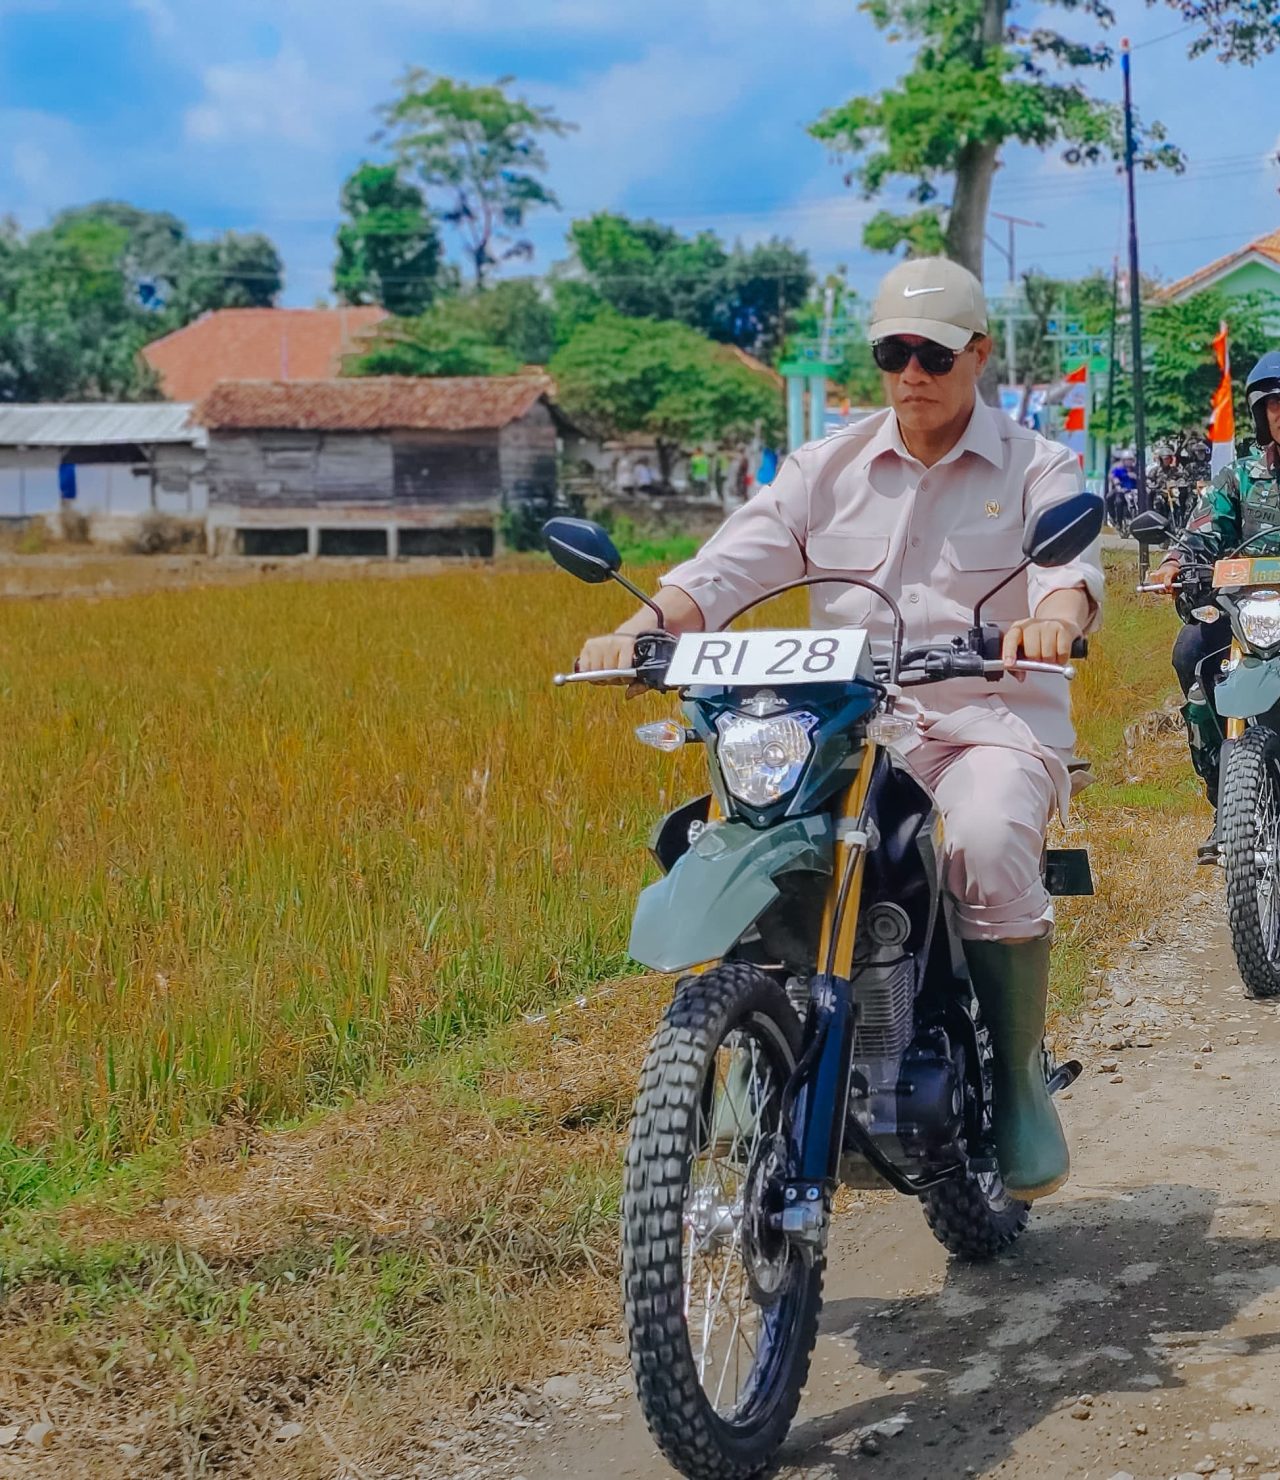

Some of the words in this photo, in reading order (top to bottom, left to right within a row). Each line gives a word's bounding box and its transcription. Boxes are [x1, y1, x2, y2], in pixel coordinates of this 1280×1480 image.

[1247, 508, 1276, 522] TONI
[691, 639, 749, 676] RI
[764, 637, 840, 675] 28
